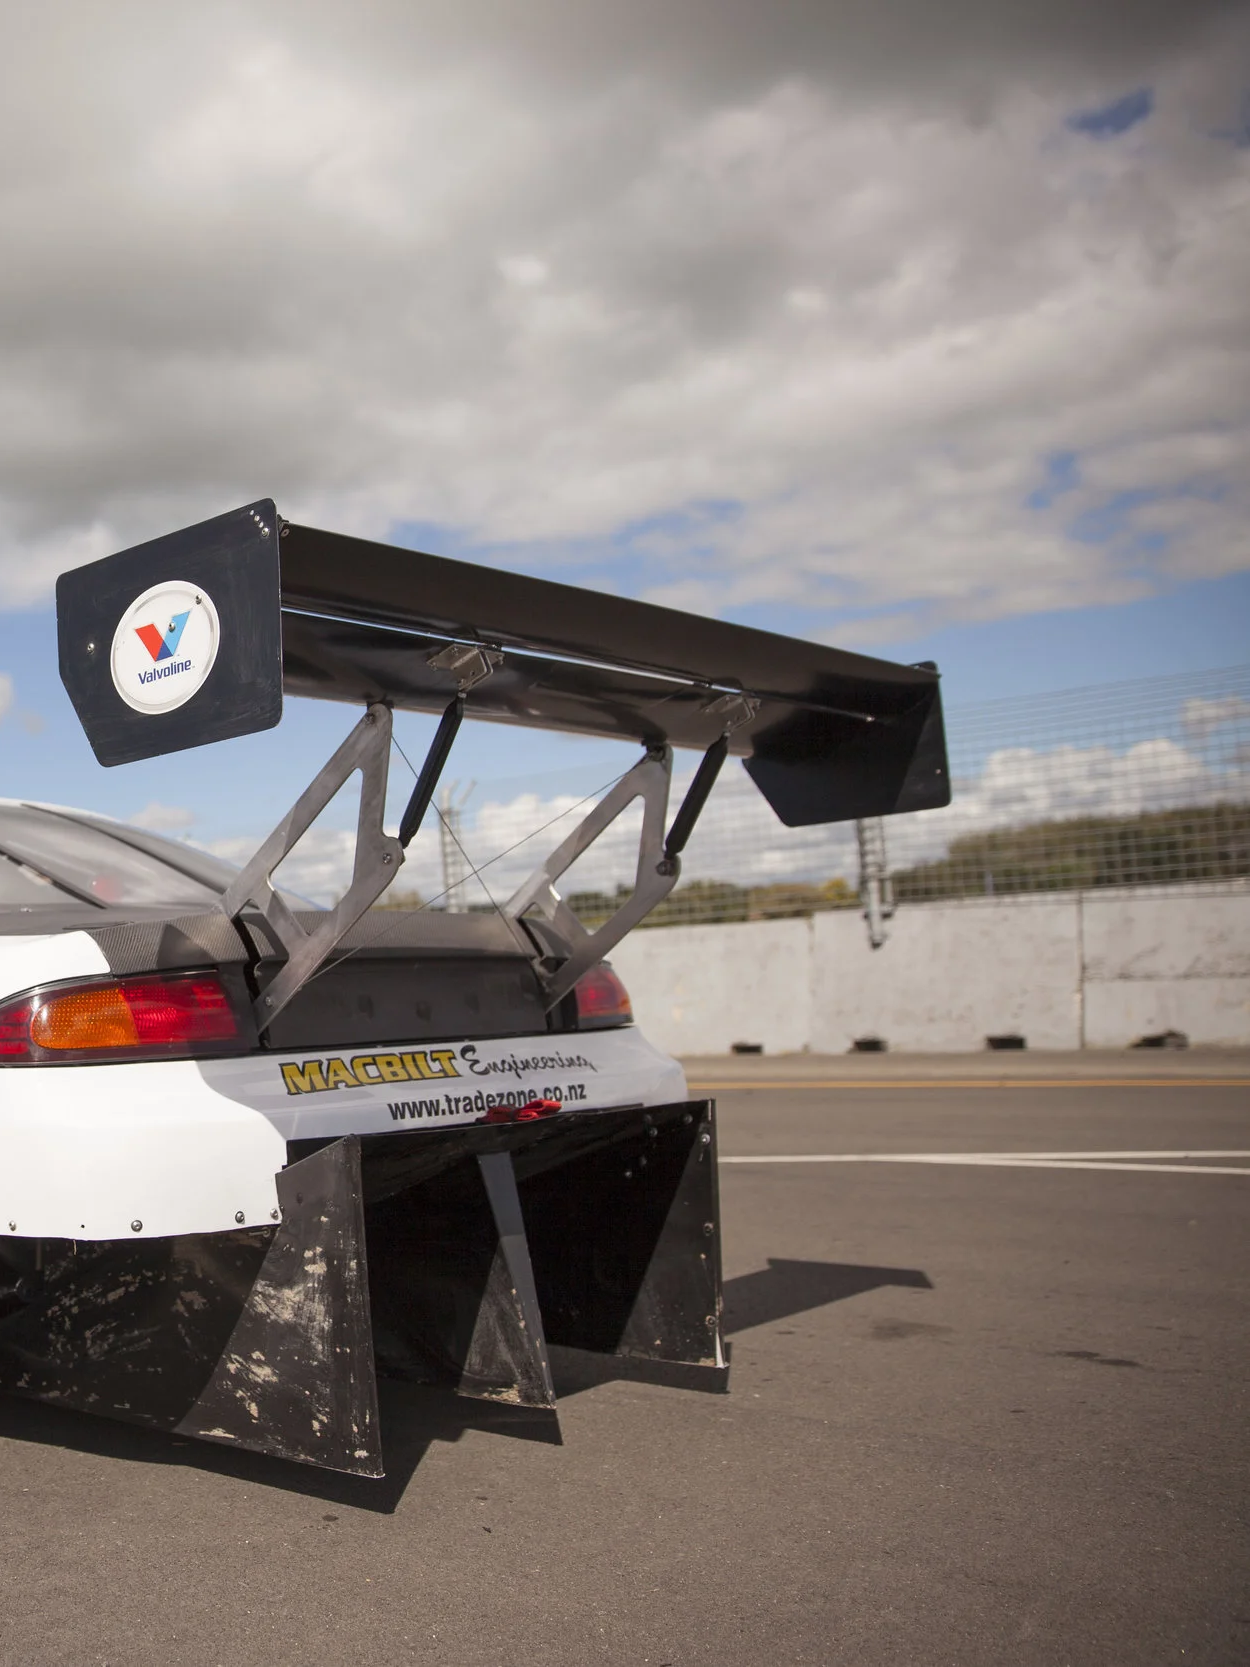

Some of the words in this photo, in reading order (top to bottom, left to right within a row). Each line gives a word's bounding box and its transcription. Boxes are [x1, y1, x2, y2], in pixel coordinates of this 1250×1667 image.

[138, 659, 192, 685] Valvoline
[278, 1049, 463, 1096] MACBILT
[460, 1044, 598, 1080] Engineering
[387, 1083, 587, 1121] www.tradezone.co.nz
